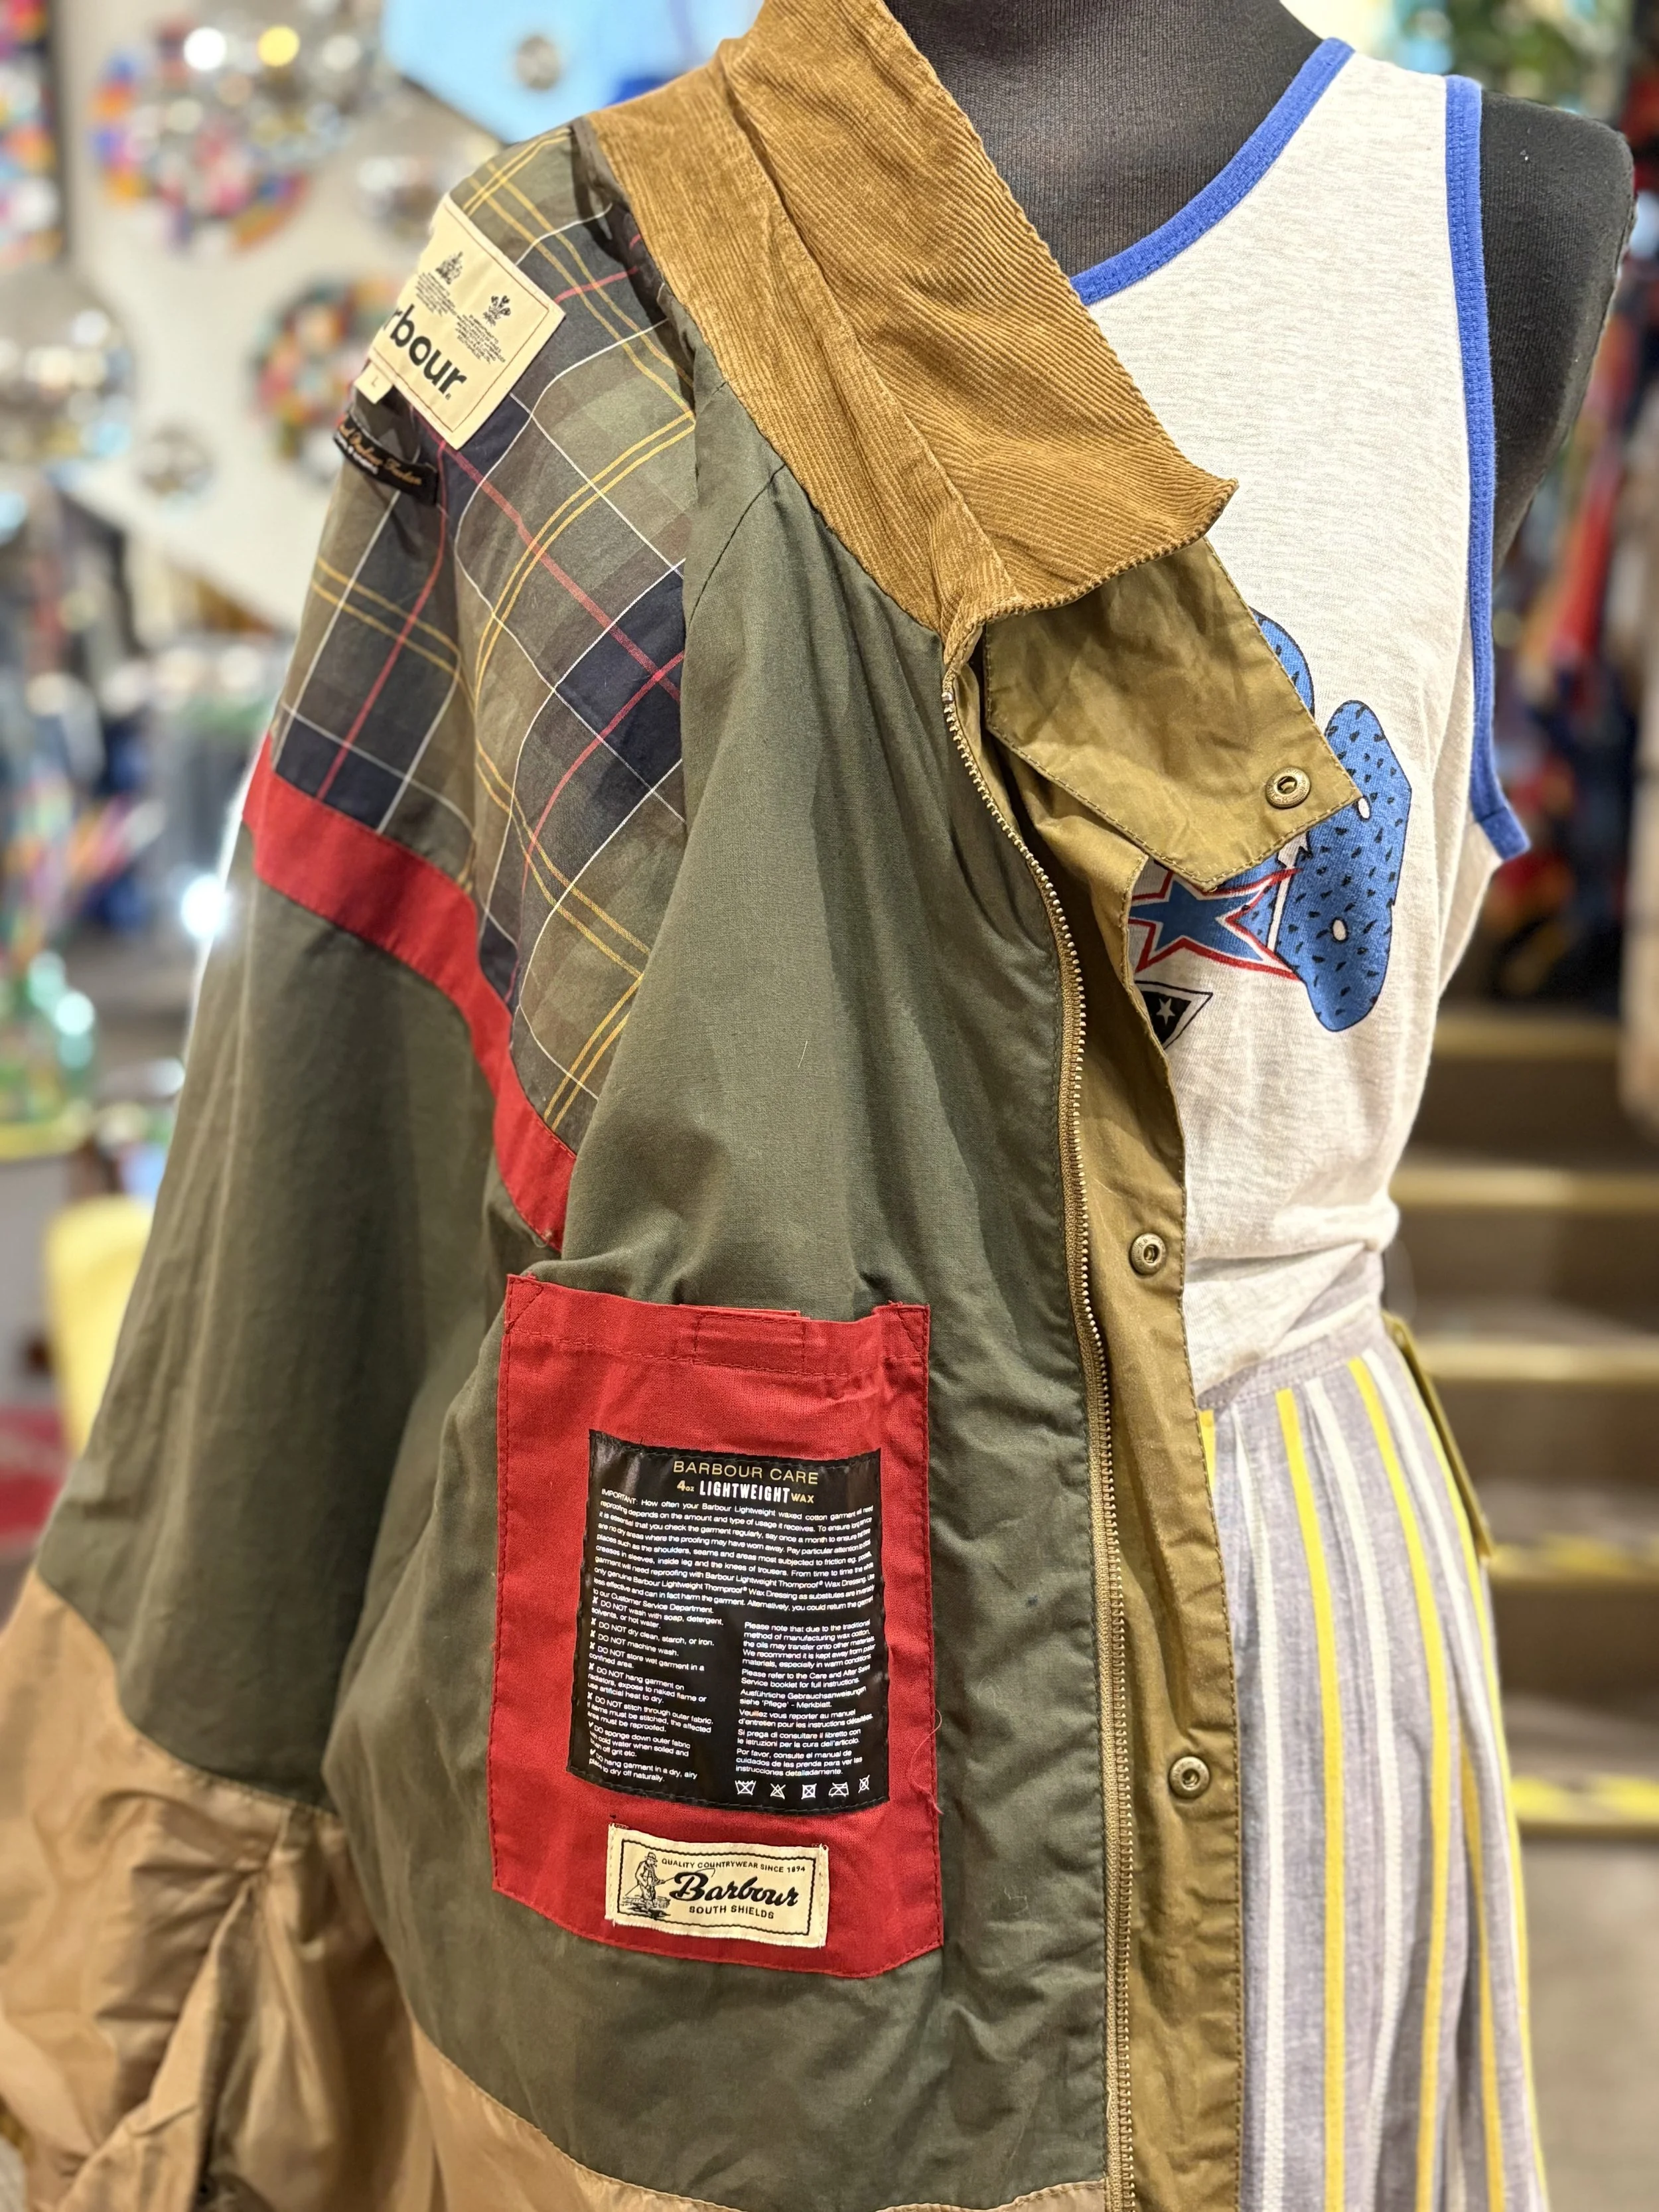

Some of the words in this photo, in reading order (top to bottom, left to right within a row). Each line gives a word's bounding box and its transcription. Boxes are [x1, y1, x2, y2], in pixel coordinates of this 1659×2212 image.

[674, 1461, 762, 1479] BARBOUR
[770, 1468, 818, 1485] CARE
[699, 1480, 790, 1504] LIGHTWEIGHT
[791, 1492, 814, 1504] WAX
[601, 1501, 627, 1514] reproofing
[628, 1509, 658, 1518] depends
[755, 1520, 777, 1529] usage
[702, 1503, 731, 1511] Barbour
[734, 1505, 776, 1516] Lightweight
[830, 1511, 855, 1520] garment
[596, 1545, 620, 1556] creases
[681, 1558, 692, 1567] leg
[724, 1562, 747, 1571] knees
[594, 1577, 606, 1585] less
[606, 1582, 630, 1592] effective
[601, 1599, 611, 1608] DO
[613, 1603, 627, 1611] NOT
[611, 1593, 641, 1605] Customer
[642, 1600, 668, 1610] Service
[611, 1624, 626, 1633] NOT
[745, 1621, 770, 1630] Please
[843, 1619, 870, 1630] traditional
[598, 1633, 609, 1642] DO
[610, 1637, 626, 1645] NOT
[627, 1641, 656, 1652] machine
[597, 1645, 608, 1654] DO
[610, 1649, 625, 1657] NOT
[658, 1660, 689, 1670] garment
[597, 1666, 607, 1675] DO
[608, 1670, 624, 1678] NOT
[625, 1674, 643, 1684] hang
[644, 1678, 674, 1688] garment
[741, 1668, 766, 1678] Please
[741, 1677, 768, 1686] Service
[618, 1682, 643, 1691] expose
[654, 1688, 675, 1697] naked
[676, 1692, 697, 1702] flame
[595, 1696, 605, 1704] DO
[607, 1699, 622, 1708] NOT
[644, 1706, 670, 1718] through
[739, 1709, 767, 1718] Veuillez
[831, 1709, 855, 1718] manuel
[662, 1858, 695, 1868] QUALITY
[697, 1860, 758, 1870] COUNTRYWEAR
[760, 1864, 784, 1873] SINCE
[669, 1872, 799, 1907] Barbour
[689, 1905, 727, 1915] SOUTH
[731, 1905, 774, 1919] SHIELDS
